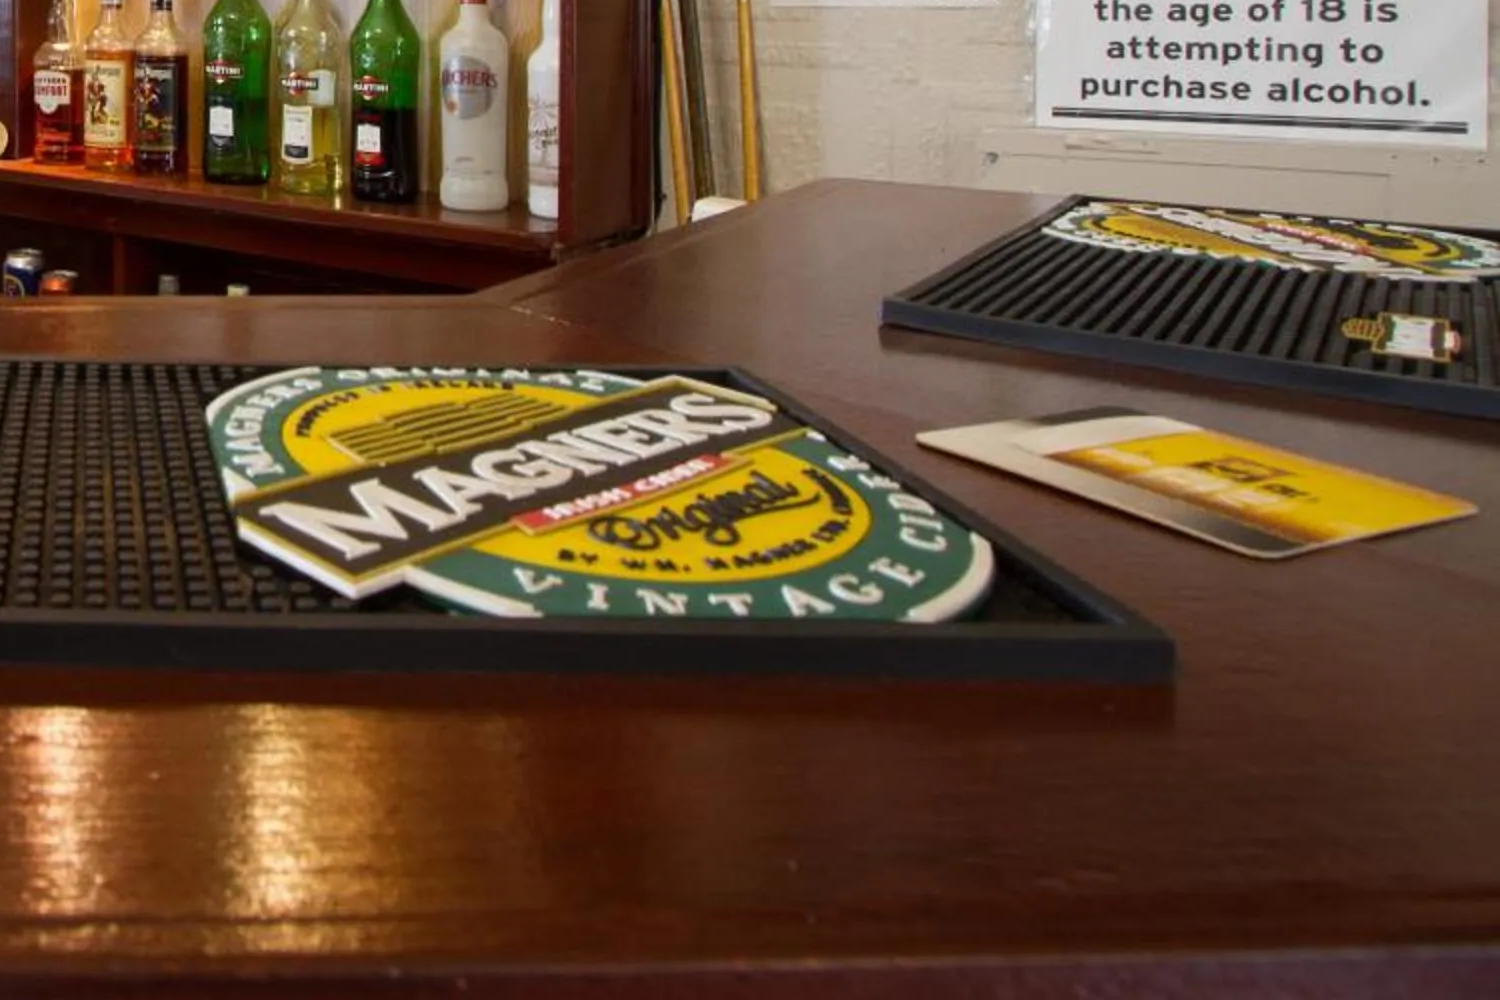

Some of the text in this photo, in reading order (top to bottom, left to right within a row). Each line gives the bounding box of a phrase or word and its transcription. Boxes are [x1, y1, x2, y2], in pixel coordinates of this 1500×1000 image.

[1167, 2, 1233, 27] age
[1106, 36, 1385, 68] attempting to
[1080, 74, 1432, 107] purchase alcohol.
[224, 376, 325, 478] MAGNERS
[258, 390, 779, 560] MAGNERS
[542, 485, 632, 520] IRISH
[587, 469, 822, 550] Original
[513, 557, 925, 618] VINTAGE
